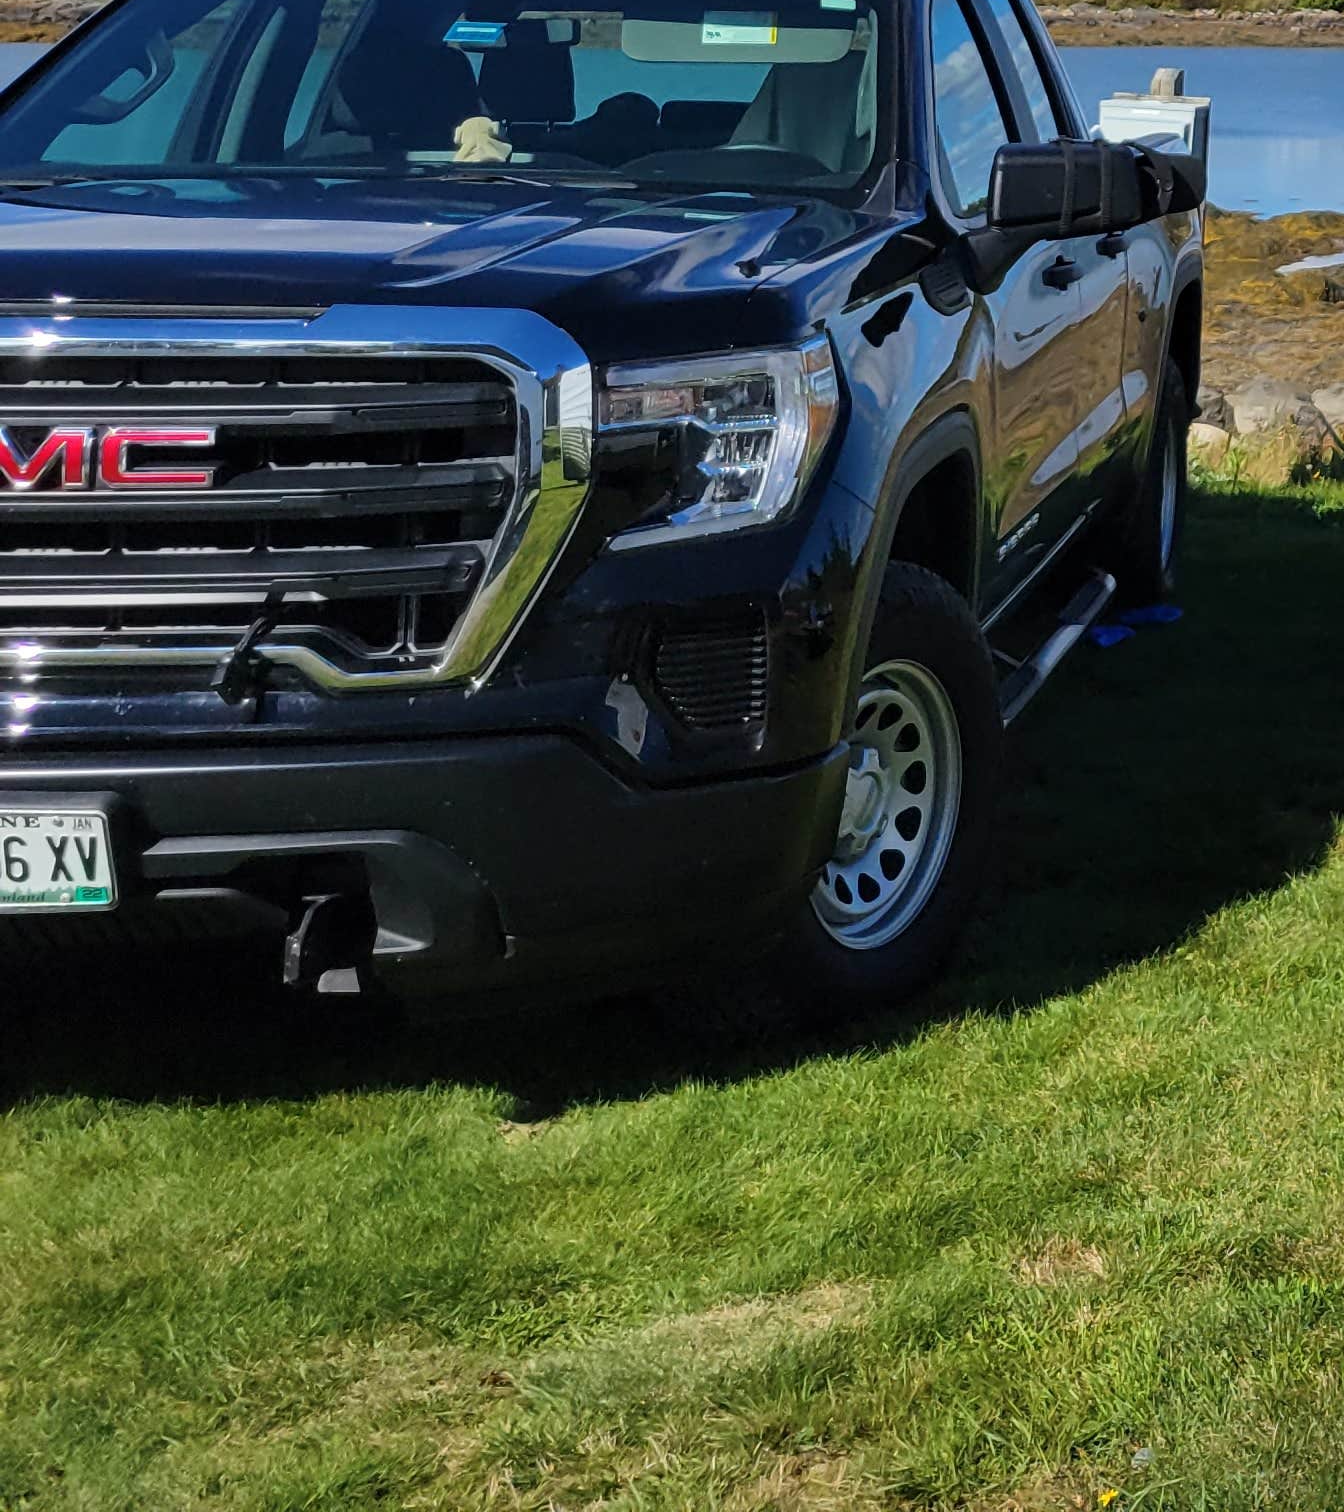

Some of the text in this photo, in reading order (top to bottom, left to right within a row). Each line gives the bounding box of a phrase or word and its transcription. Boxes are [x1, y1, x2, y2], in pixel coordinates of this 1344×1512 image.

[0, 424, 217, 490] MC
[0, 835, 98, 883] 6 XV
[82, 889, 102, 898] 22
